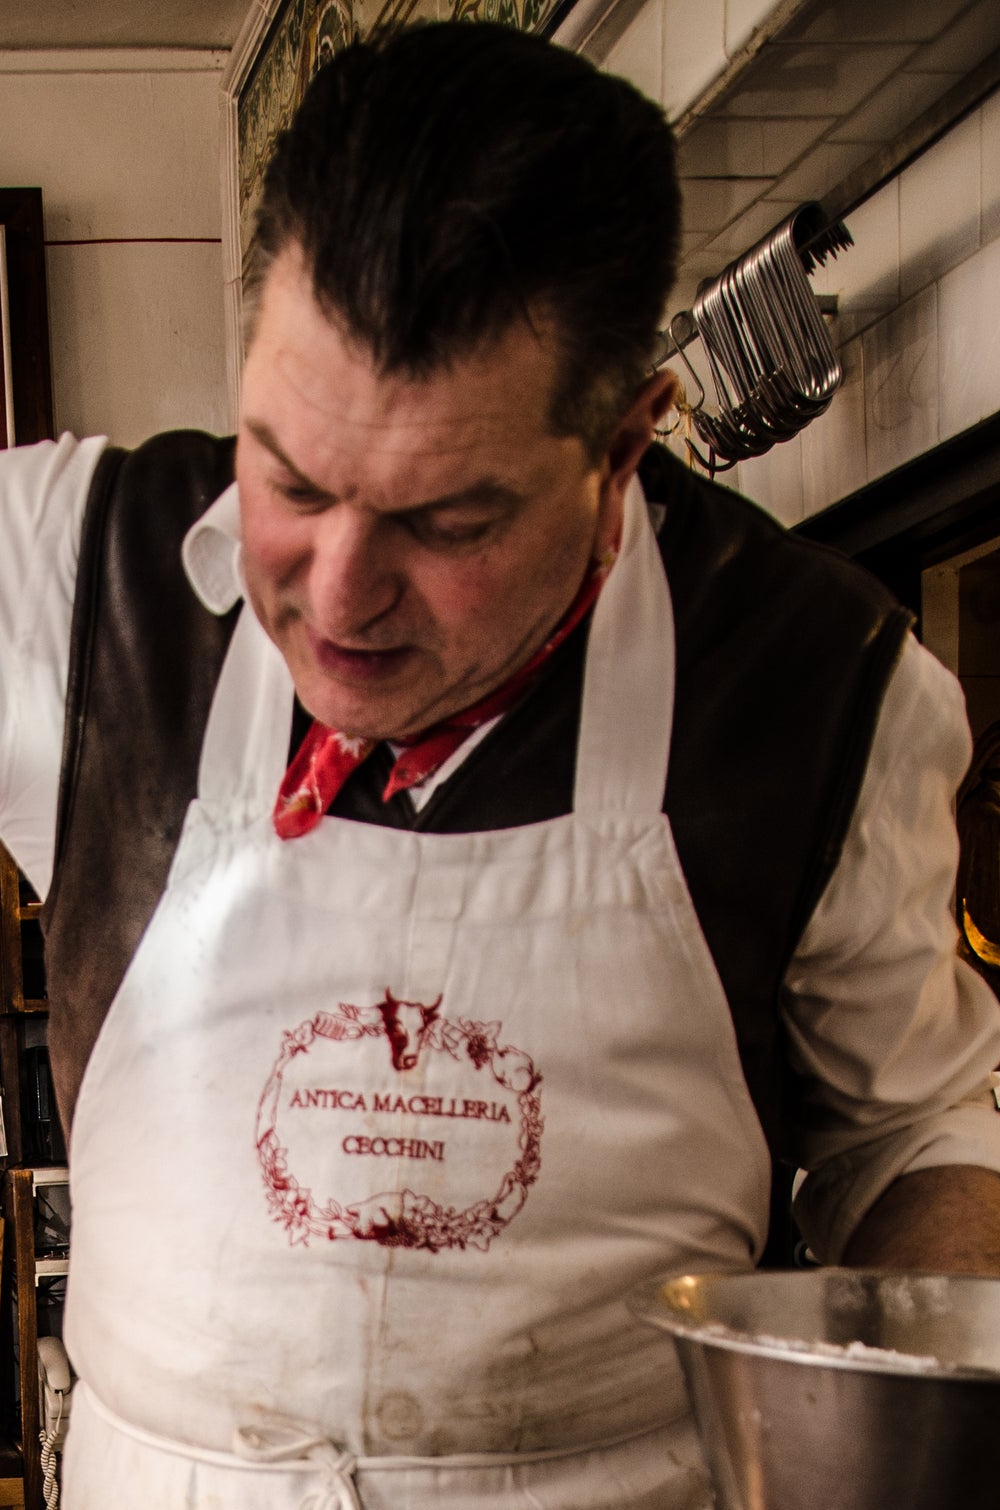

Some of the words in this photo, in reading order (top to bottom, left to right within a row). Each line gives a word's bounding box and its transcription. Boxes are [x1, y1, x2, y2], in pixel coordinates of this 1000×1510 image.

[289, 1089, 367, 1112] ANTICA
[372, 1092, 511, 1124] MACELLERIA
[341, 1135, 446, 1162] CECCHINI
